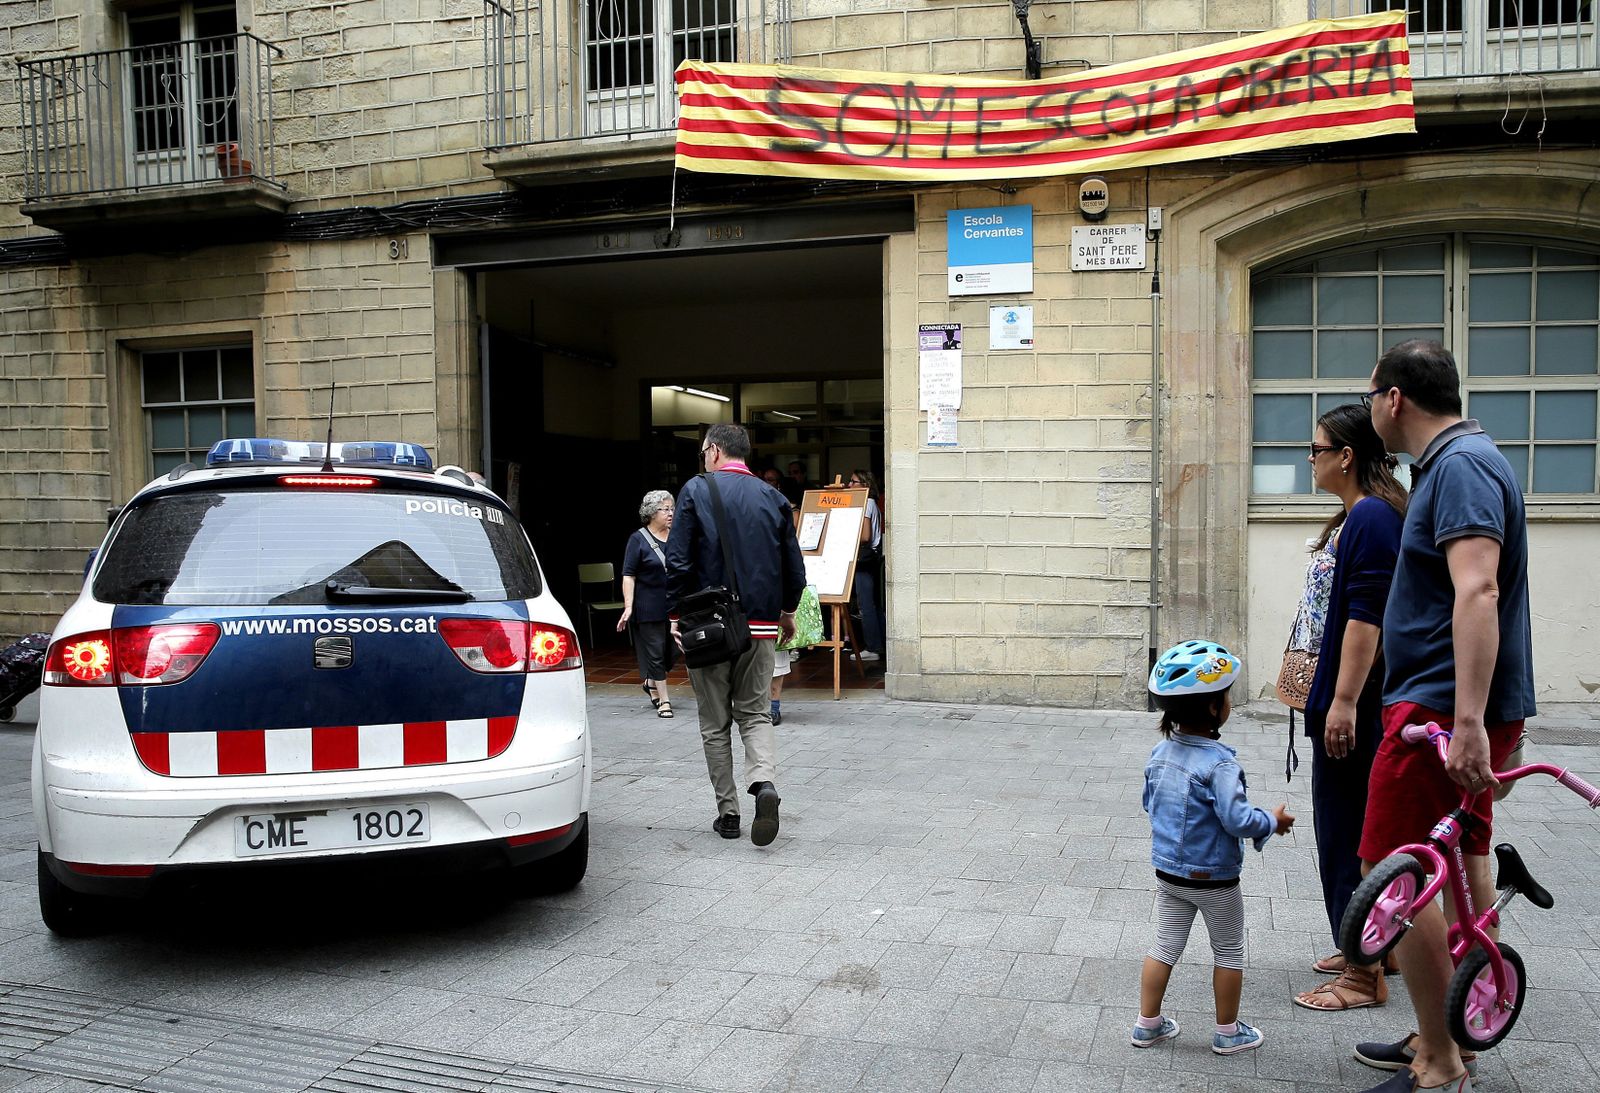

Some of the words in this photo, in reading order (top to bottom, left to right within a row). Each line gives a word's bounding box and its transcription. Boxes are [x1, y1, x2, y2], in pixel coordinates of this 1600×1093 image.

[767, 78, 957, 160] SOM
[975, 77, 1201, 154] ESCOLA
[1216, 40, 1397, 118] OBERTA
[963, 214, 1003, 226] Escola
[963, 227, 1024, 239] Cervantes
[1090, 228, 1127, 236] CARRER
[388, 239, 408, 260] 31
[1079, 246, 1106, 256] SANT
[1111, 245, 1138, 255] PERE
[1109, 257, 1131, 265] BAIX
[955, 273, 964, 282] e
[921, 324, 960, 333] CONNECTADA
[405, 498, 483, 519] policia
[221, 615, 436, 636] www.mossos.cat
[246, 817, 308, 850] CME
[353, 808, 424, 841] 1802
